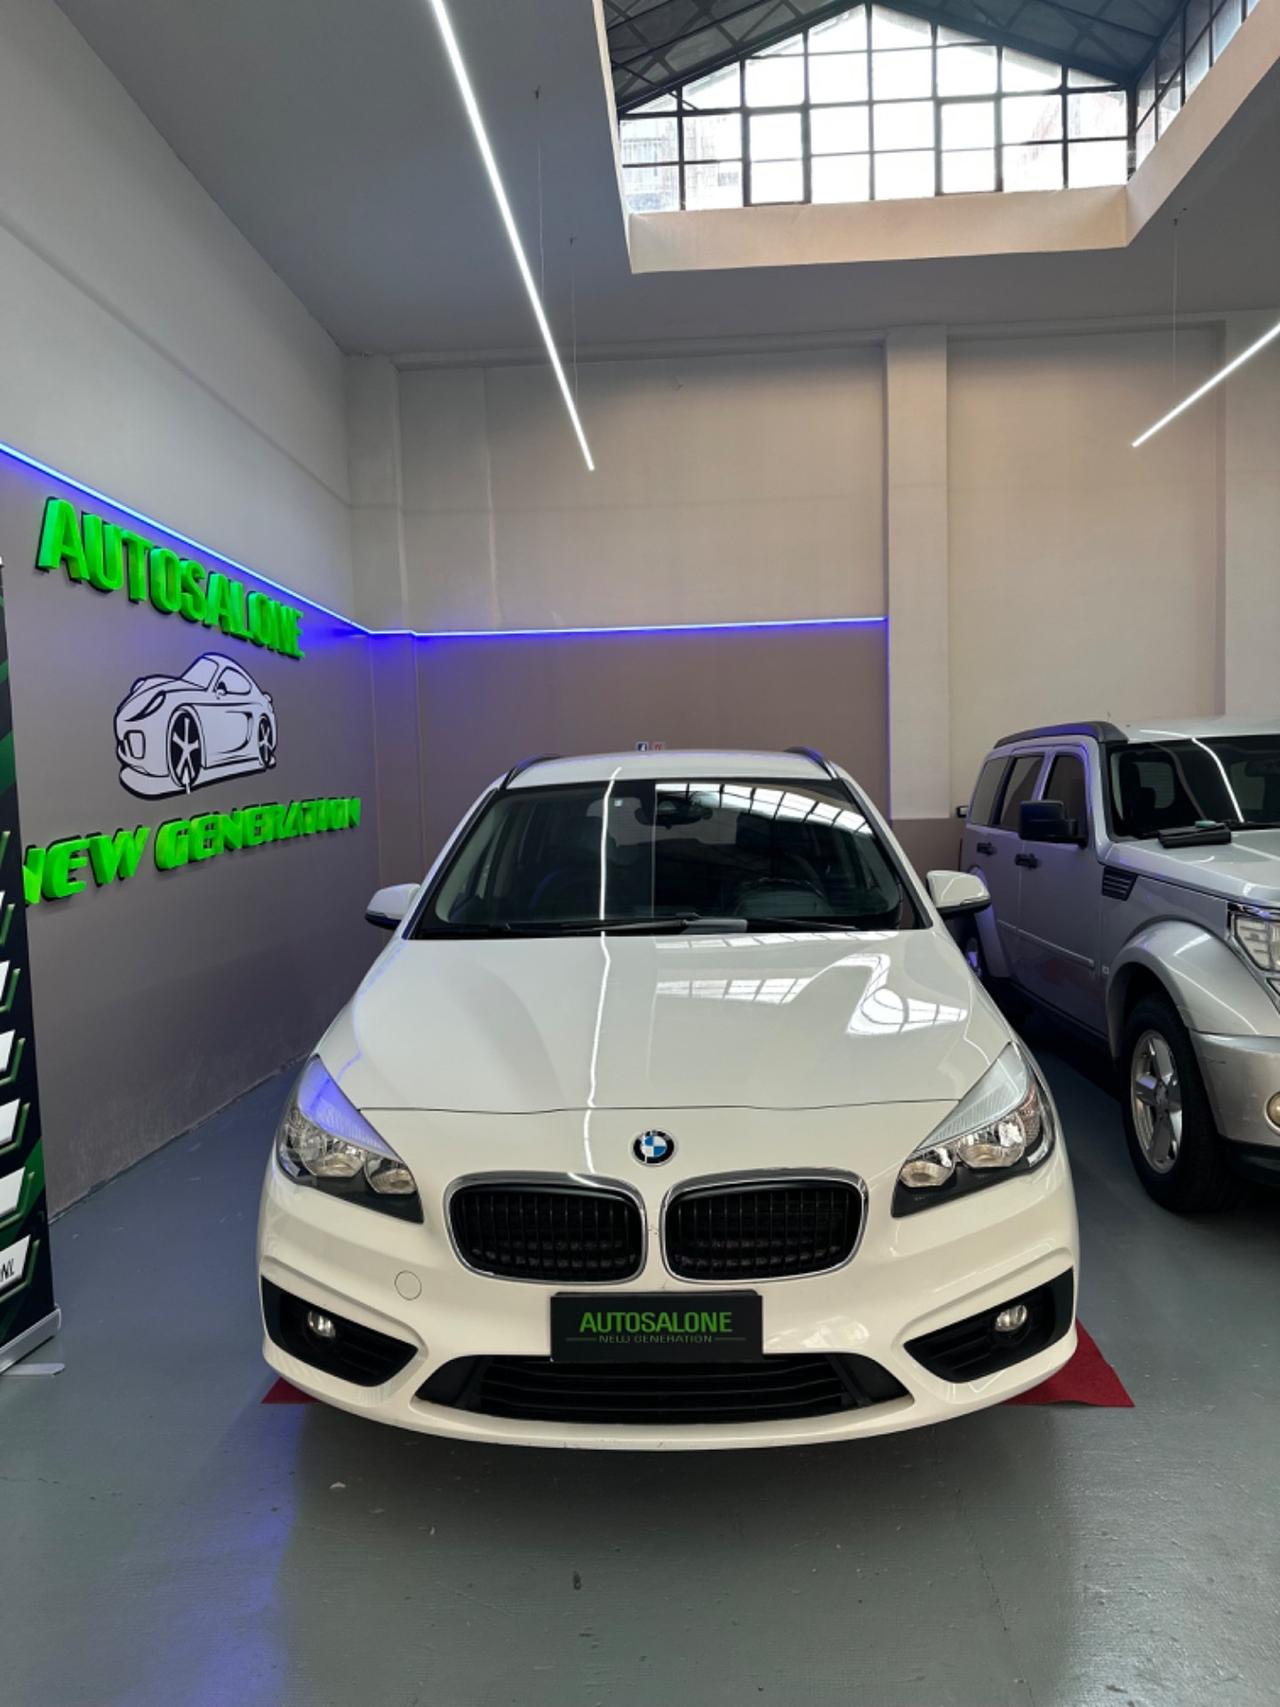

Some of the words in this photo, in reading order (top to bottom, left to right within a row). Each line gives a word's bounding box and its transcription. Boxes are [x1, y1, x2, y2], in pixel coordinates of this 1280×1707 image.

[36, 497, 305, 660] AUTOSALONE
[154, 796, 361, 872] GENERATION
[579, 1311, 733, 1333] AUTOSALONE
[599, 1334, 631, 1344] NEW
[634, 1334, 713, 1344] GENERATION
